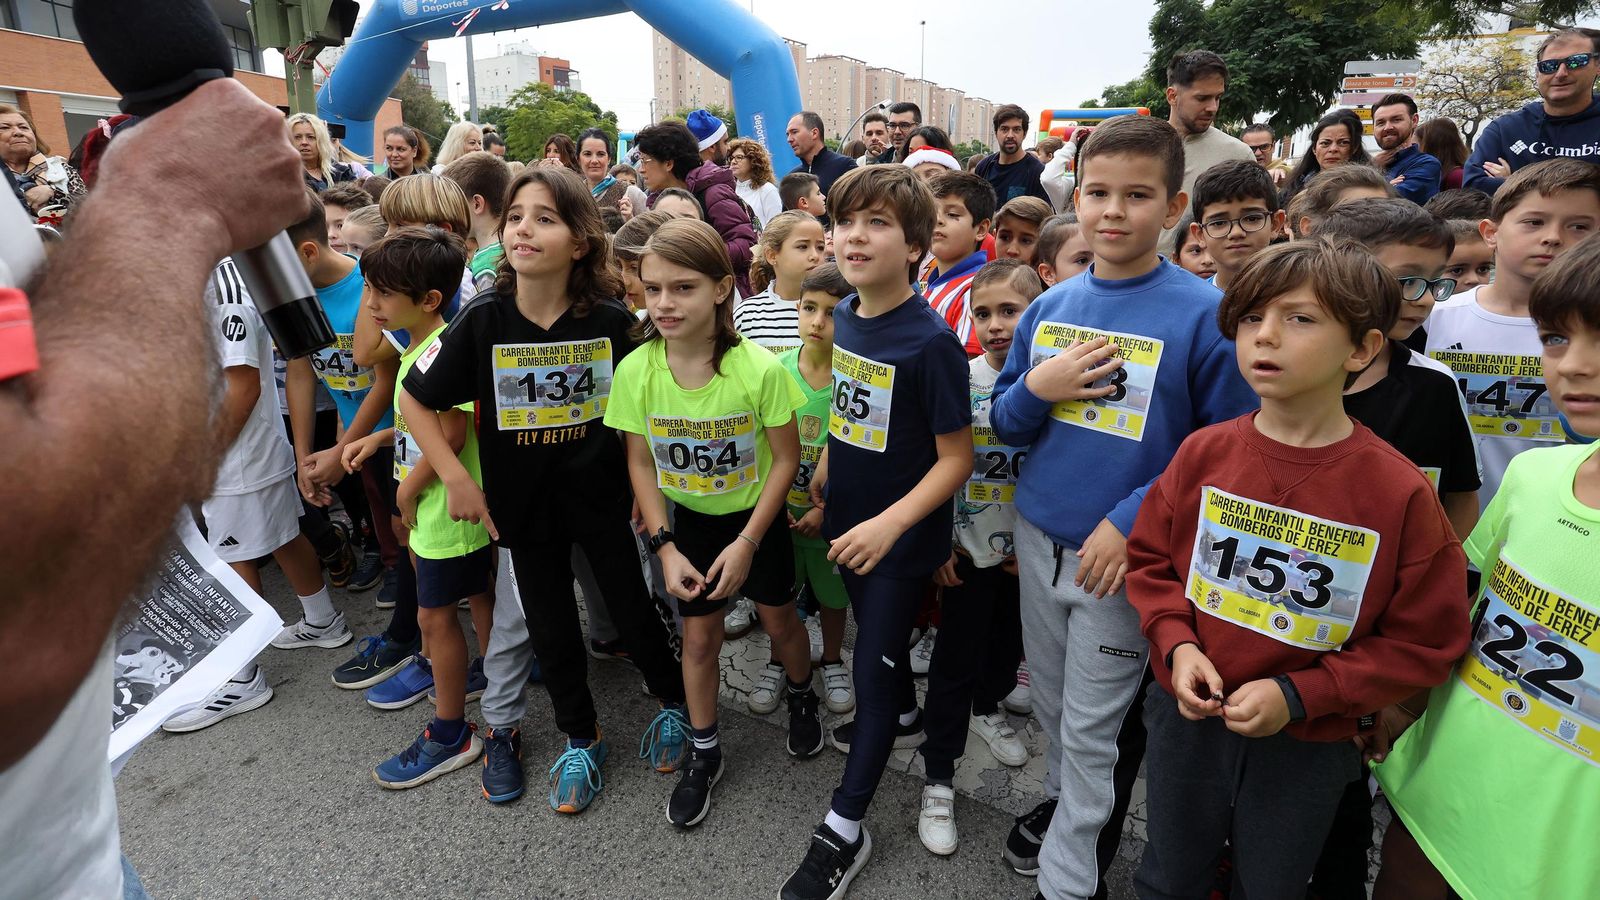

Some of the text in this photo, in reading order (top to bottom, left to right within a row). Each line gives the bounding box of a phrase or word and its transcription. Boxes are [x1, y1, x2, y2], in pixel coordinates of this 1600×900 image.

[422, 0, 469, 13] Deportes
[226, 315, 245, 342] hp
[1043, 324, 1077, 339] CARRERA
[1113, 336, 1153, 353] BENEFICA
[501, 341, 606, 358] CARRERA INFANTIL BENEFICA
[517, 353, 593, 367] BOMBEROS DE JEREZ
[1435, 352, 1473, 363] CARRERA
[1475, 354, 1518, 365] INFANTIL
[858, 361, 888, 378] BENEFICA
[1451, 363, 1500, 375] BOMBEROS
[1503, 366, 1517, 376] DE
[518, 367, 596, 403] 134
[517, 425, 587, 446] FLY BETTER
[653, 418, 686, 428] CARRERA
[714, 415, 749, 428] BENEFICA
[667, 428, 736, 440] BOMBEROS DE JEREZ
[669, 441, 741, 473] 064
[1210, 492, 1366, 547] CARRERA INFANTIL BENEFICA
[1557, 518, 1590, 537] ARTENGO
[1219, 511, 1341, 557] BOMBEROS DE JEREZ
[168, 549, 240, 620] CARRERA INFANTIL
[1211, 536, 1334, 609] 153
[174, 571, 205, 600] BOMBEROS
[204, 598, 213, 607] DE
[212, 607, 230, 624] JEREZ
[1506, 565, 1551, 609] INFANTIL
[146, 597, 183, 630] Inscripción
[1523, 600, 1545, 619] DE
[1545, 613, 1594, 647] JEREZ
